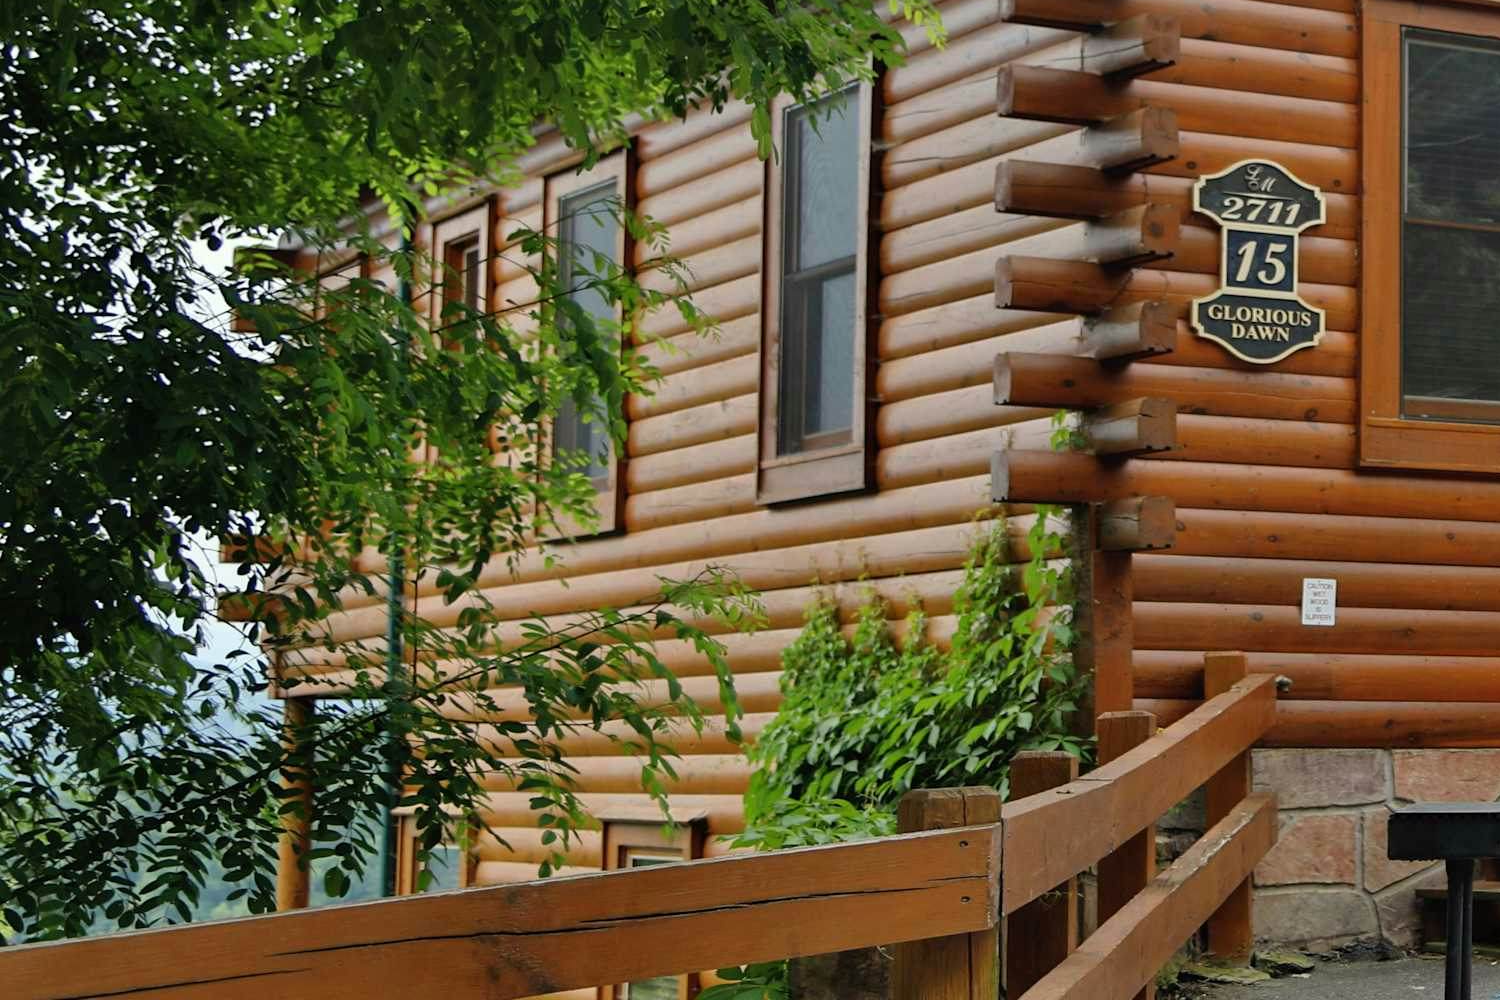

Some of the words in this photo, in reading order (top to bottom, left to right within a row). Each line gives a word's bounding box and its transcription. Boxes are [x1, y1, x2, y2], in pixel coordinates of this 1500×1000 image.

[1220, 198, 1301, 225] 2711
[1235, 240, 1288, 285] 15
[1207, 304, 1313, 326] GLORIOUS
[1231, 323, 1291, 342] DAWN
